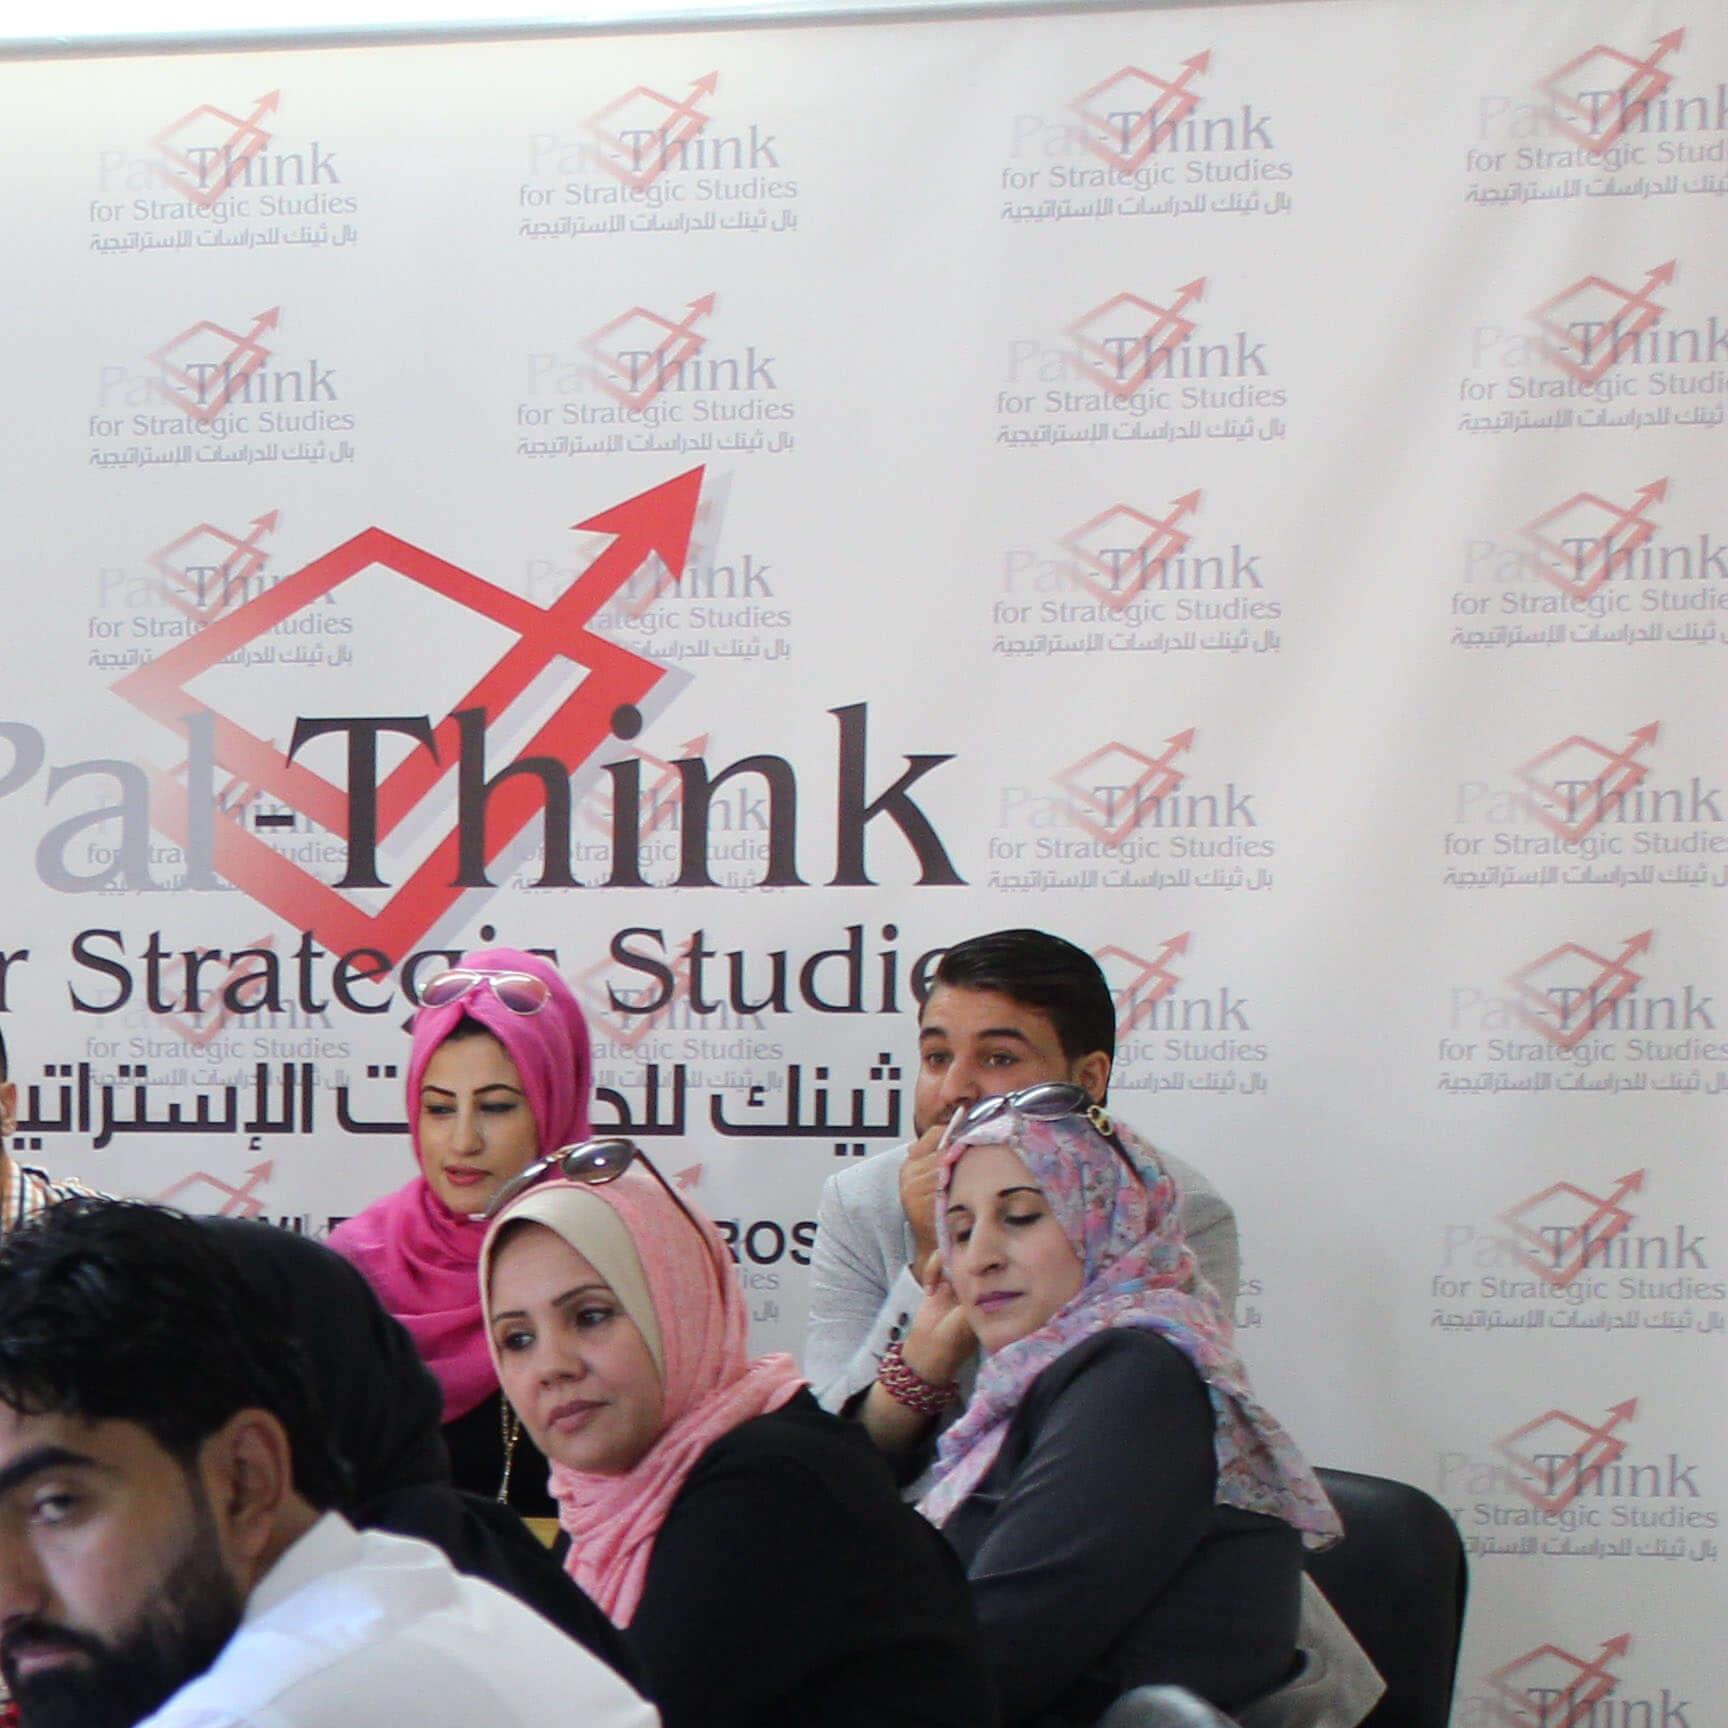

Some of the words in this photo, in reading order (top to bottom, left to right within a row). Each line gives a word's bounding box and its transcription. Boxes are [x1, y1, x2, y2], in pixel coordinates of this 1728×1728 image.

[1467, 148, 1507, 172] for
[1002, 167, 1041, 189] for
[1049, 164, 1177, 192] Strategic
[1186, 159, 1293, 183] Studies
[519, 184, 556, 206] for
[564, 182, 687, 209] Strategic
[696, 177, 798, 201] Studies
[89, 200, 125, 222] for
[133, 198, 251, 224] Strategic
[259, 193, 358, 216] Studies
[1459, 377, 1499, 400] for
[998, 391, 1036, 413] for
[1044, 390, 1172, 416] Strategic
[1181, 386, 1288, 409] Studies
[89, 415, 125, 437] for
[132, 414, 250, 439] Strategic
[258, 410, 356, 433] Studies
[517, 403, 554, 425] for
[562, 403, 684, 428] Strategic
[693, 399, 795, 421] Studies
[994, 601, 1032, 623] for
[1040, 602, 1167, 627] Strategic
[1176, 598, 1282, 620] Studies
[1452, 592, 1492, 614] for
[91, 616, 126, 637] for
[689, 606, 791, 628] Studies
[989, 837, 1027, 859] for
[1035, 839, 1161, 863] Strategic
[1170, 836, 1275, 858] Studies
[1445, 833, 1485, 855] for
[86, 1037, 122, 1059] for
[253, 1037, 351, 1059] Studies
[683, 1037, 784, 1060] Studies
[1165, 1039, 1267, 1061] Studies
[1439, 1039, 1479, 1061] for
[710, 1053, 901, 1156] ثينك
[1432, 1276, 1472, 1298] for
[1479, 1278, 1609, 1304] Strategic
[1618, 1278, 1727, 1301] Studies
[1611, 1506, 1719, 1529] Studies
